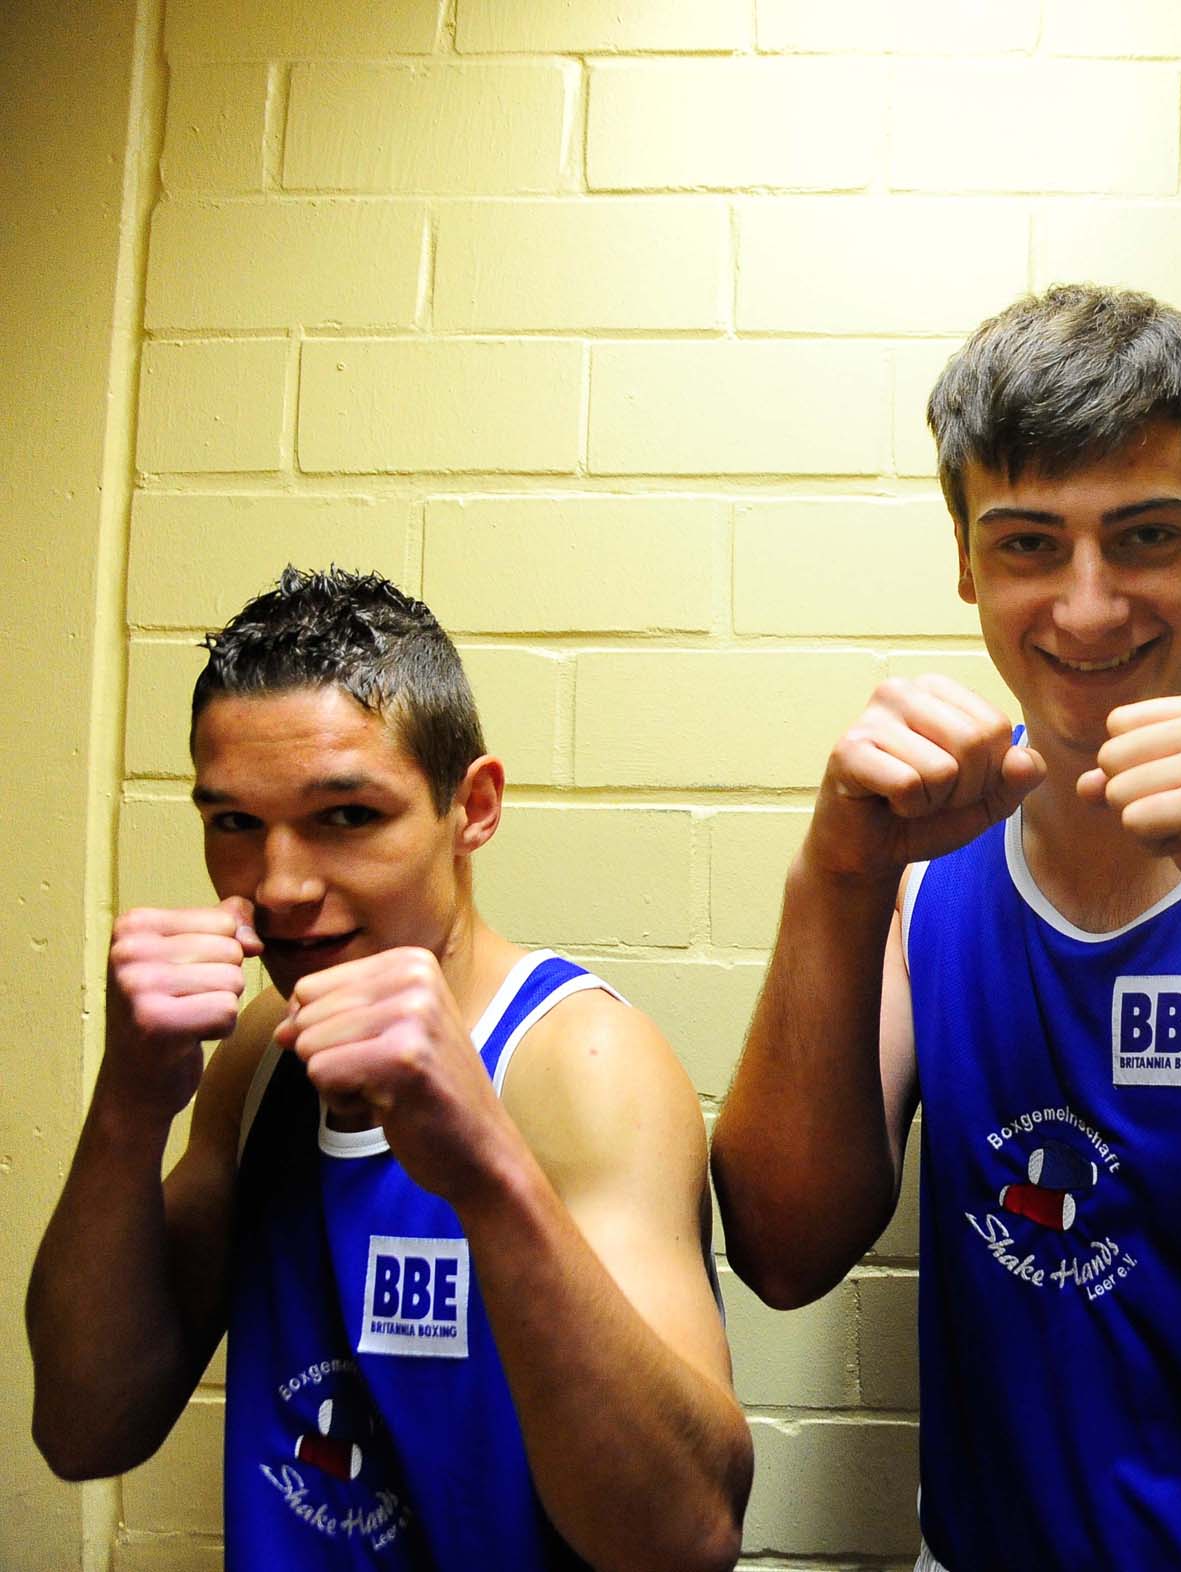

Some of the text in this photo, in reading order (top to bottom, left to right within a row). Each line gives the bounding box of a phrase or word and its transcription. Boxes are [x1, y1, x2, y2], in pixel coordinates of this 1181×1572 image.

[1119, 1057, 1172, 1070] BRITANNIA
[986, 1105, 1121, 1174] Boxgemeinschaft
[965, 1211, 1120, 1289] Shake Hands
[372, 1254, 458, 1321] BBE
[1086, 1276, 1116, 1300] Leer
[370, 1320, 458, 1338] BRITANNIA BOXING
[258, 1462, 337, 1536] Shake
